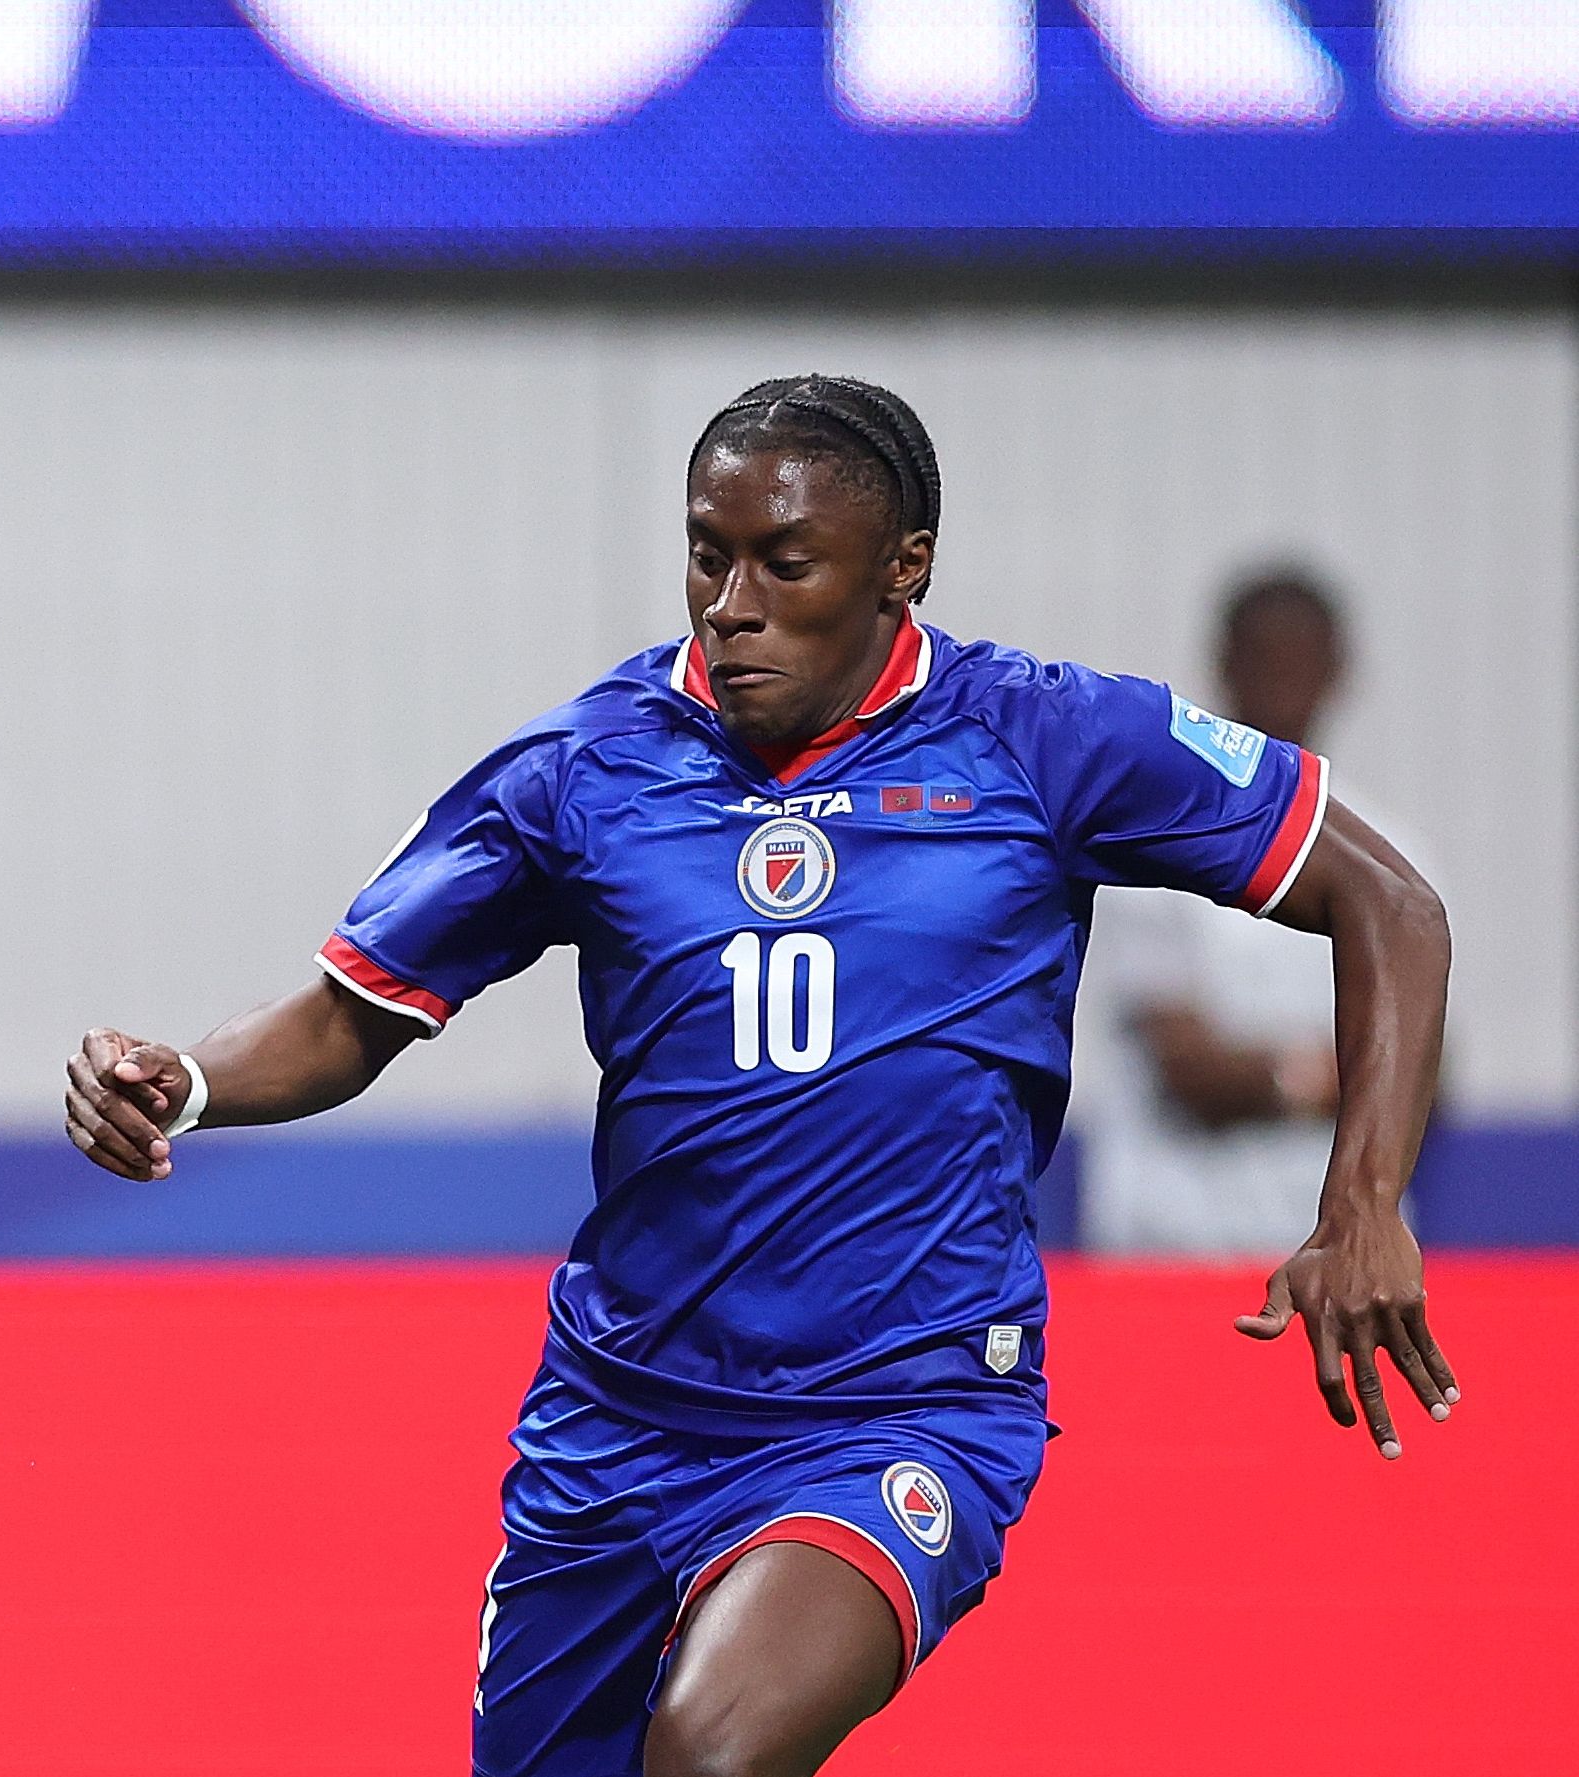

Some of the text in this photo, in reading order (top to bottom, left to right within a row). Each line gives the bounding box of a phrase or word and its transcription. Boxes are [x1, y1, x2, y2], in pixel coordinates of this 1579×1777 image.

[722, 790, 853, 819] SAETA
[768, 842, 802, 853] HAITI
[720, 931, 836, 1073] 10
